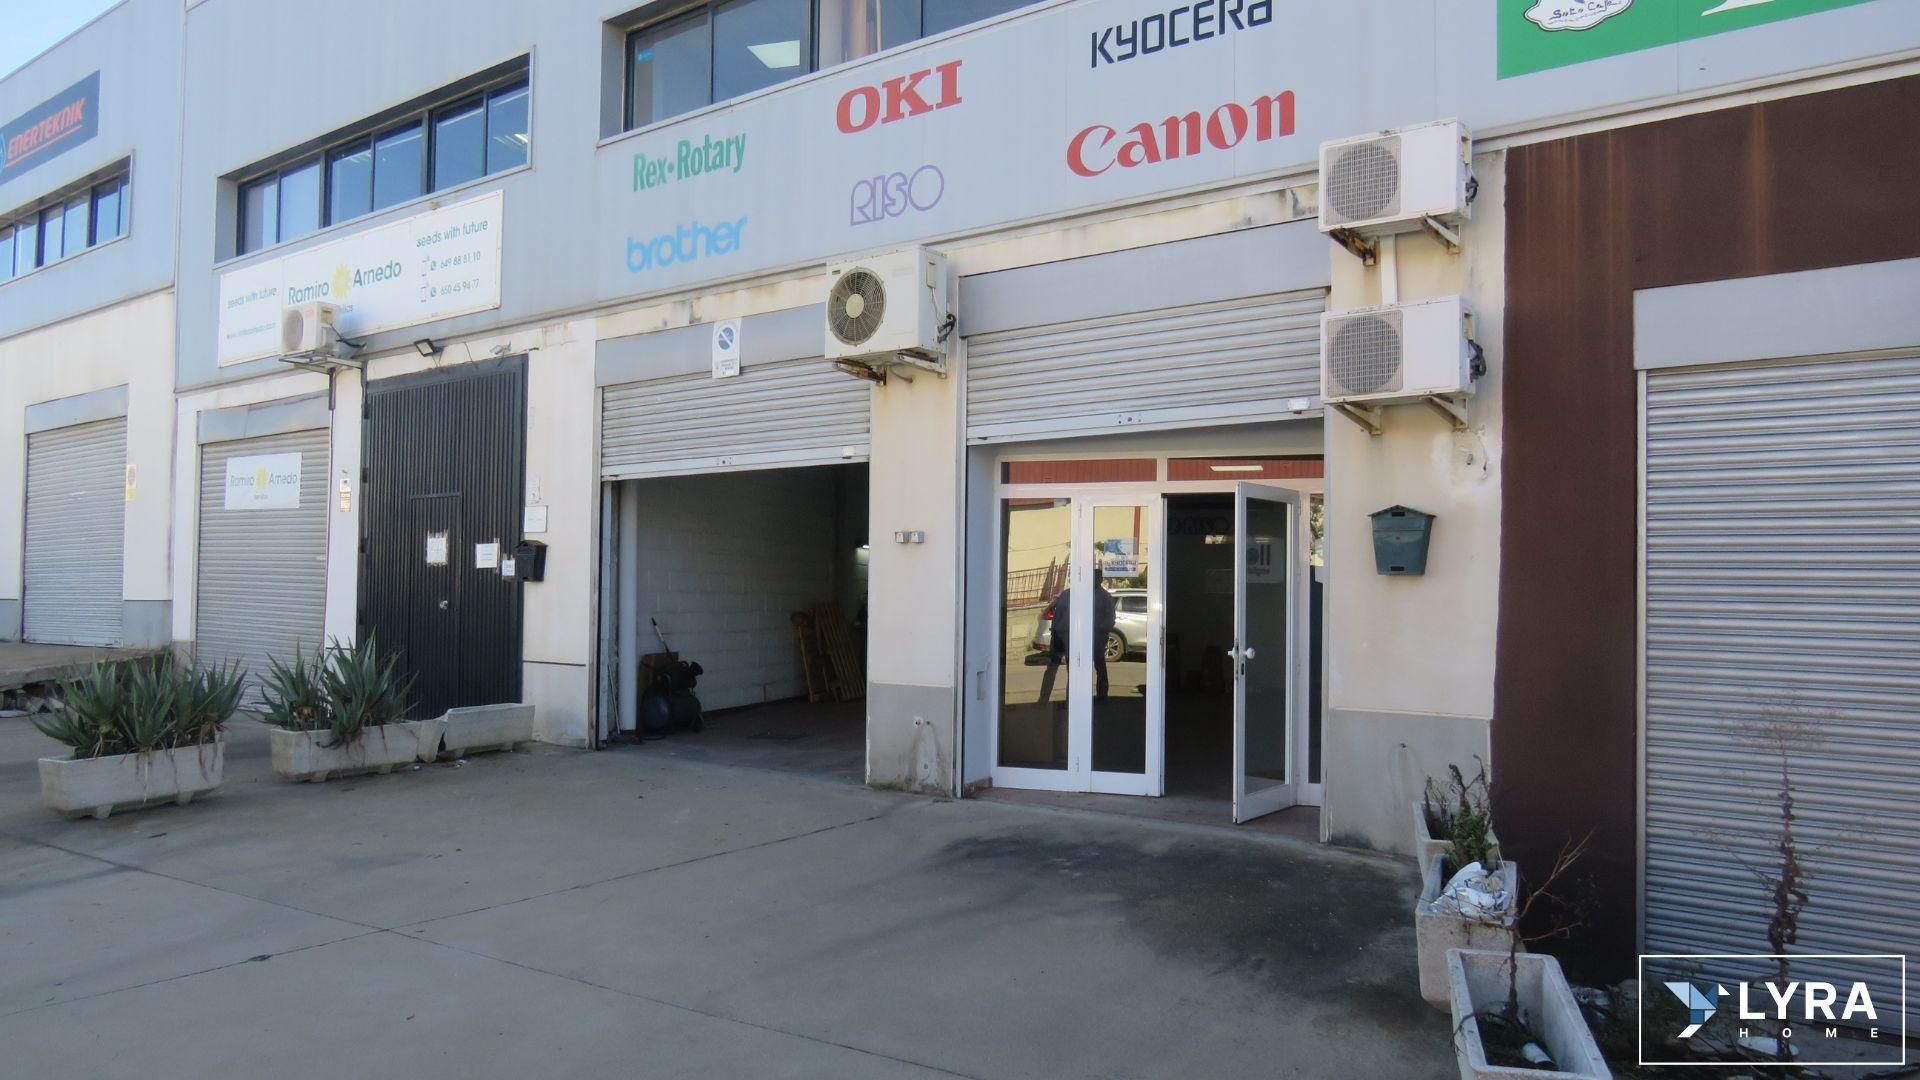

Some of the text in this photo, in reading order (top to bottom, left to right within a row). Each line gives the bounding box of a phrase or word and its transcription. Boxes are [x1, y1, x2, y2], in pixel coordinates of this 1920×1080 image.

[836, 59, 963, 134] OKI
[1066, 90, 1295, 177] Canon
[850, 164, 945, 226] RISO
[416, 219, 489, 248] seeds with future
[625, 214, 748, 273] brother
[288, 260, 403, 305] Ramiro Arnedo
